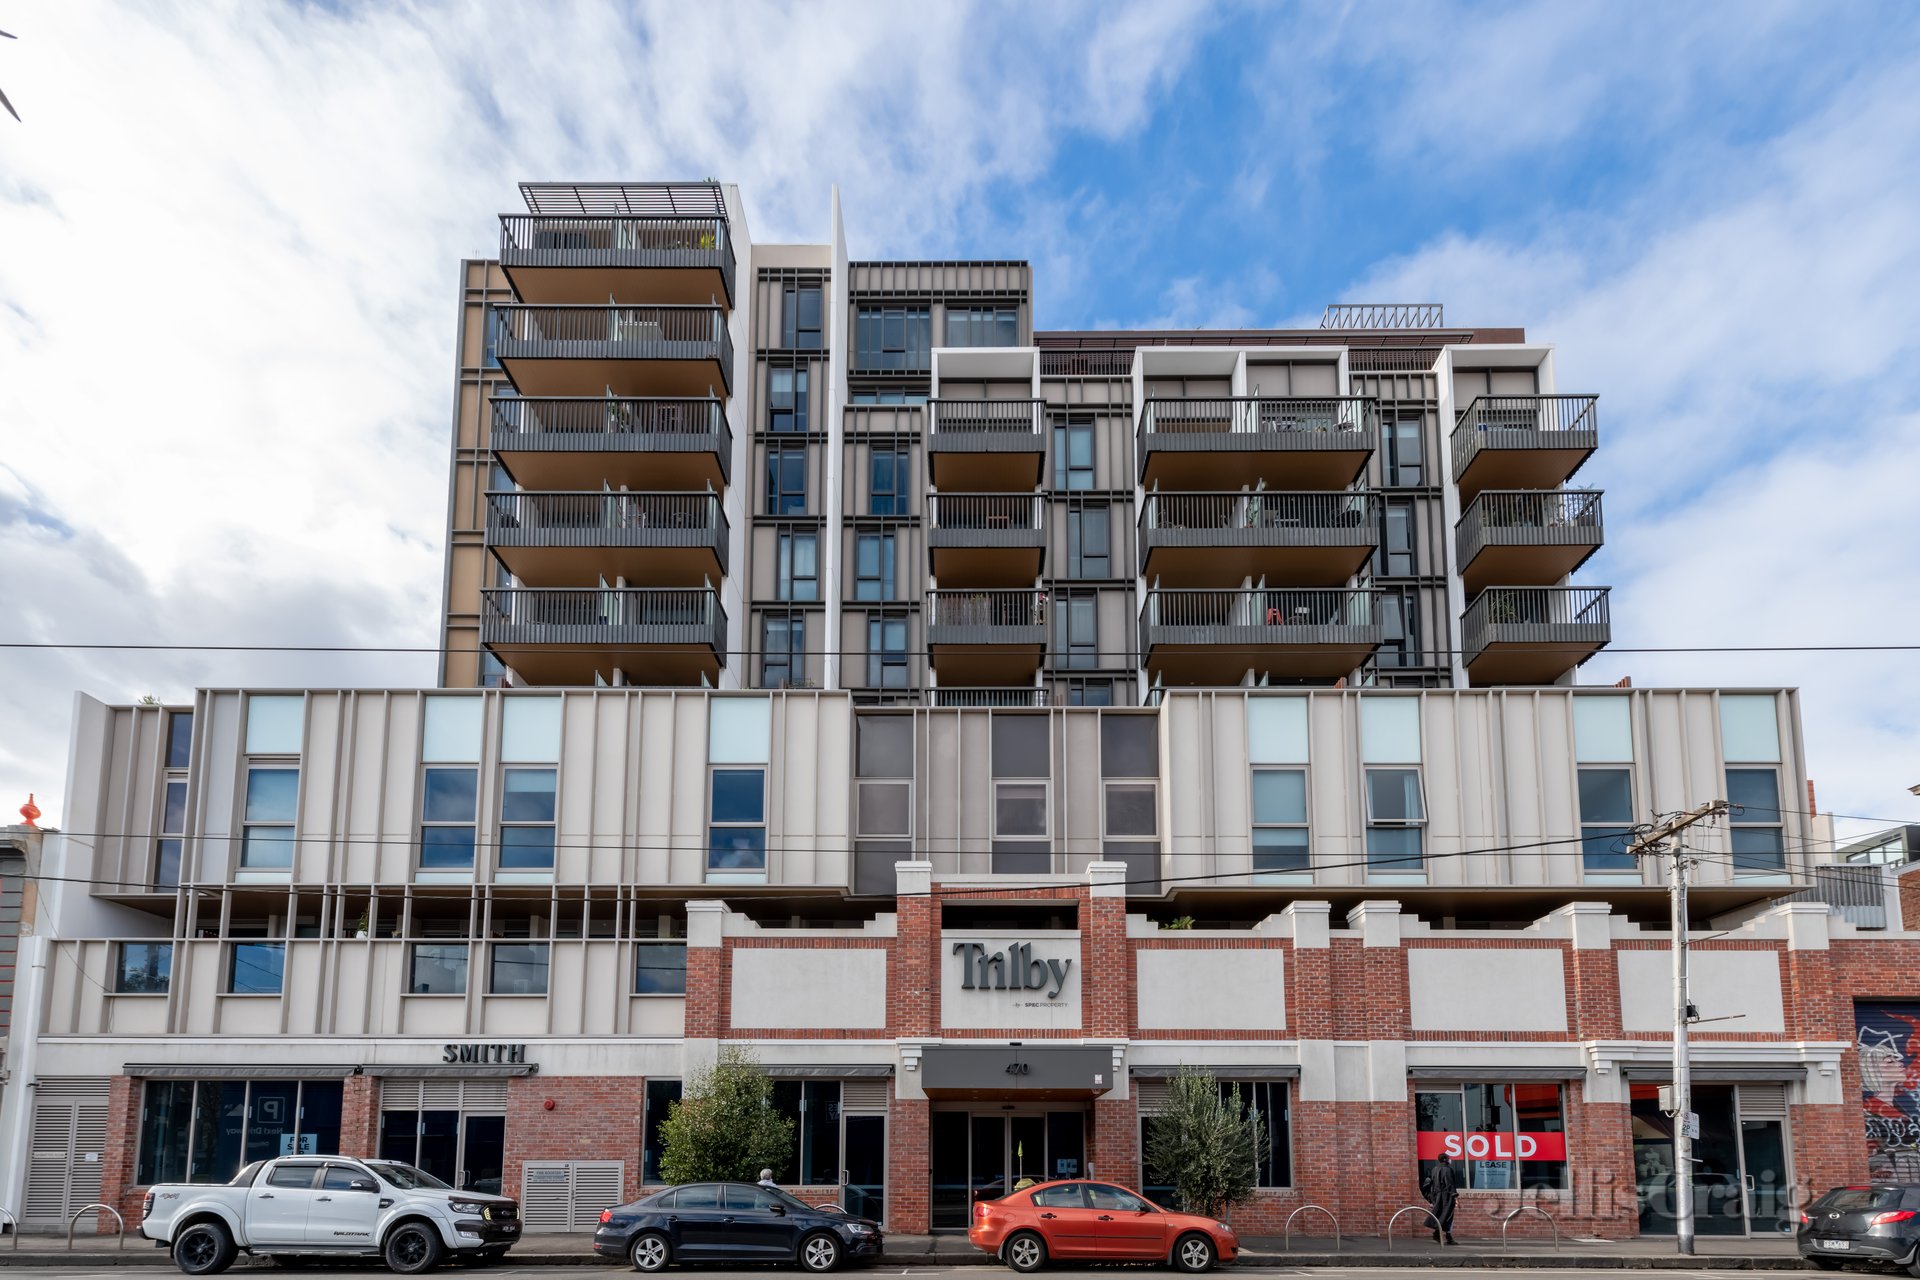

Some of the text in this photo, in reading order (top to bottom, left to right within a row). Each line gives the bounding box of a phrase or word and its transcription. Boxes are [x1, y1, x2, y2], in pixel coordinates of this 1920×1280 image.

[952, 941, 1072, 999] Trilby
[442, 1044, 526, 1063] SMITH
[1005, 1063, 1029, 1075] 470
[1444, 1134, 1537, 1157] SOLD
